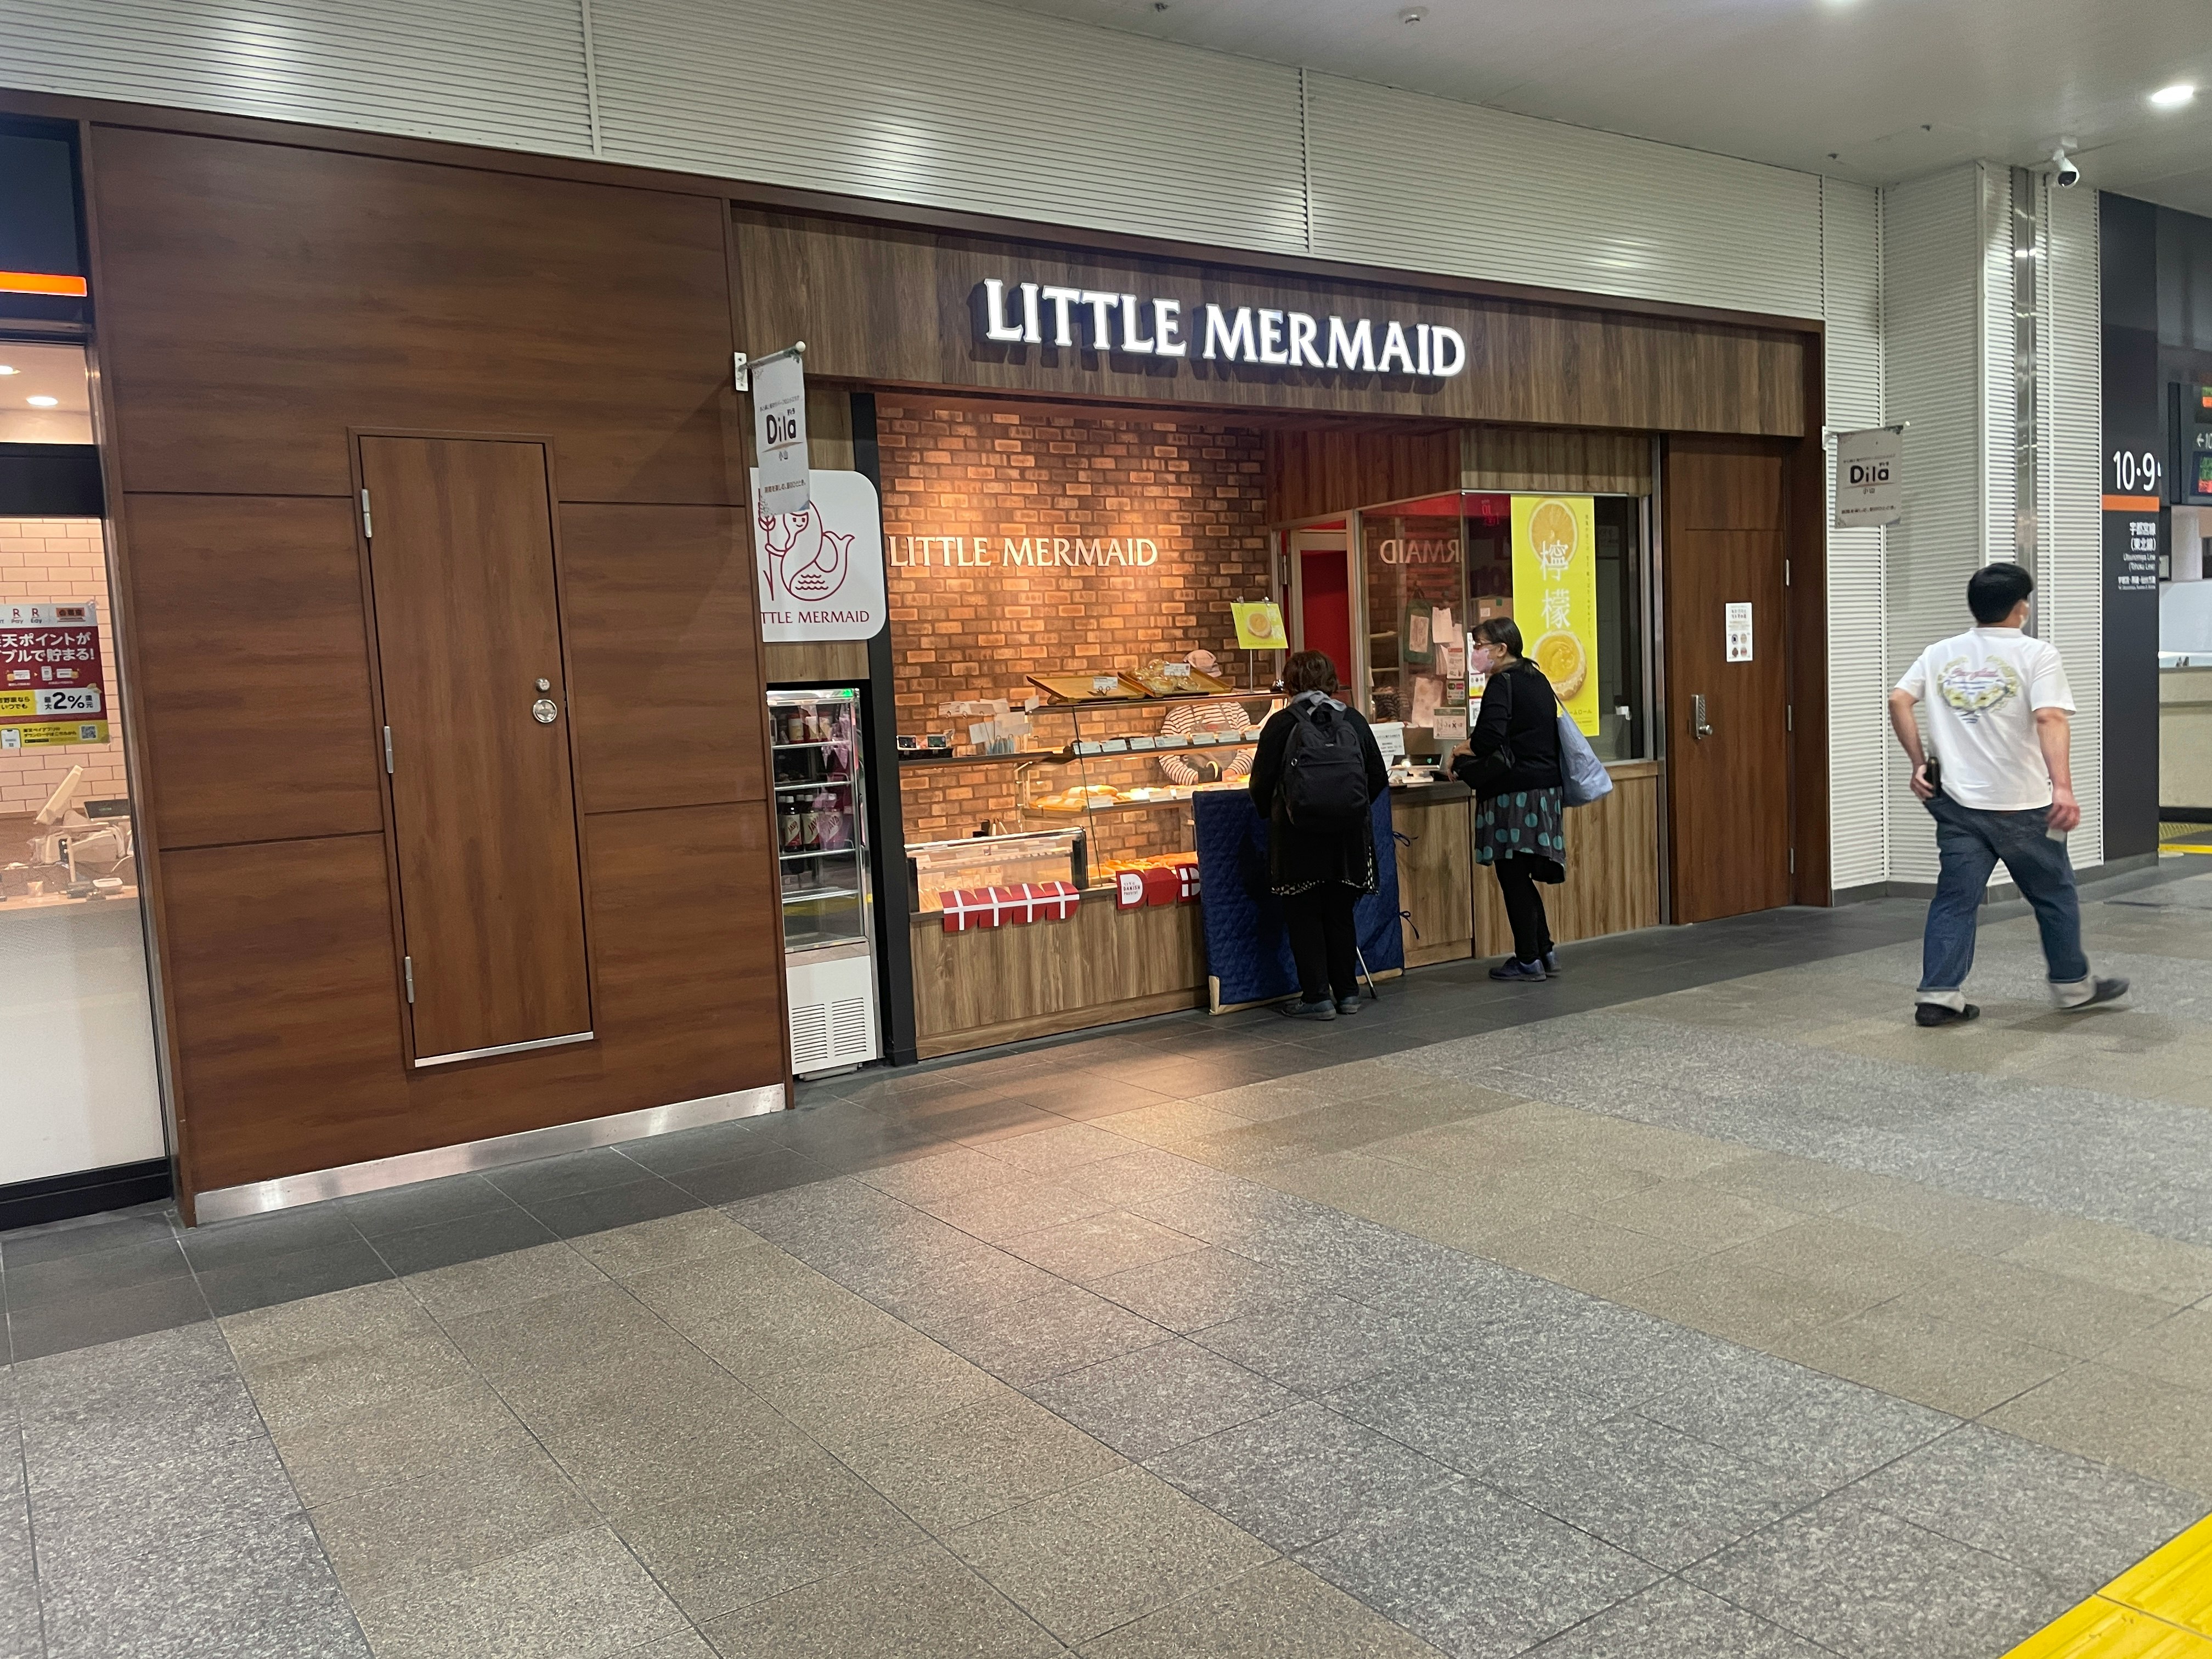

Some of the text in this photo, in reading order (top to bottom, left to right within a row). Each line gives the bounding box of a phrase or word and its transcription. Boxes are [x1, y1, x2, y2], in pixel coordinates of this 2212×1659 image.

[983, 278, 1466, 377] LITTLE MERMAID
[766, 414, 796, 444] Dila
[1850, 465, 1889, 484] Dila
[888, 536, 1159, 567] LITTLE MERMAID
[1540, 539, 1571, 629] 檸檬
[798, 611, 870, 623] MERMAID
[0, 631, 91, 648] 天ポイントが
[0, 648, 95, 663] ブルで貯まる!
